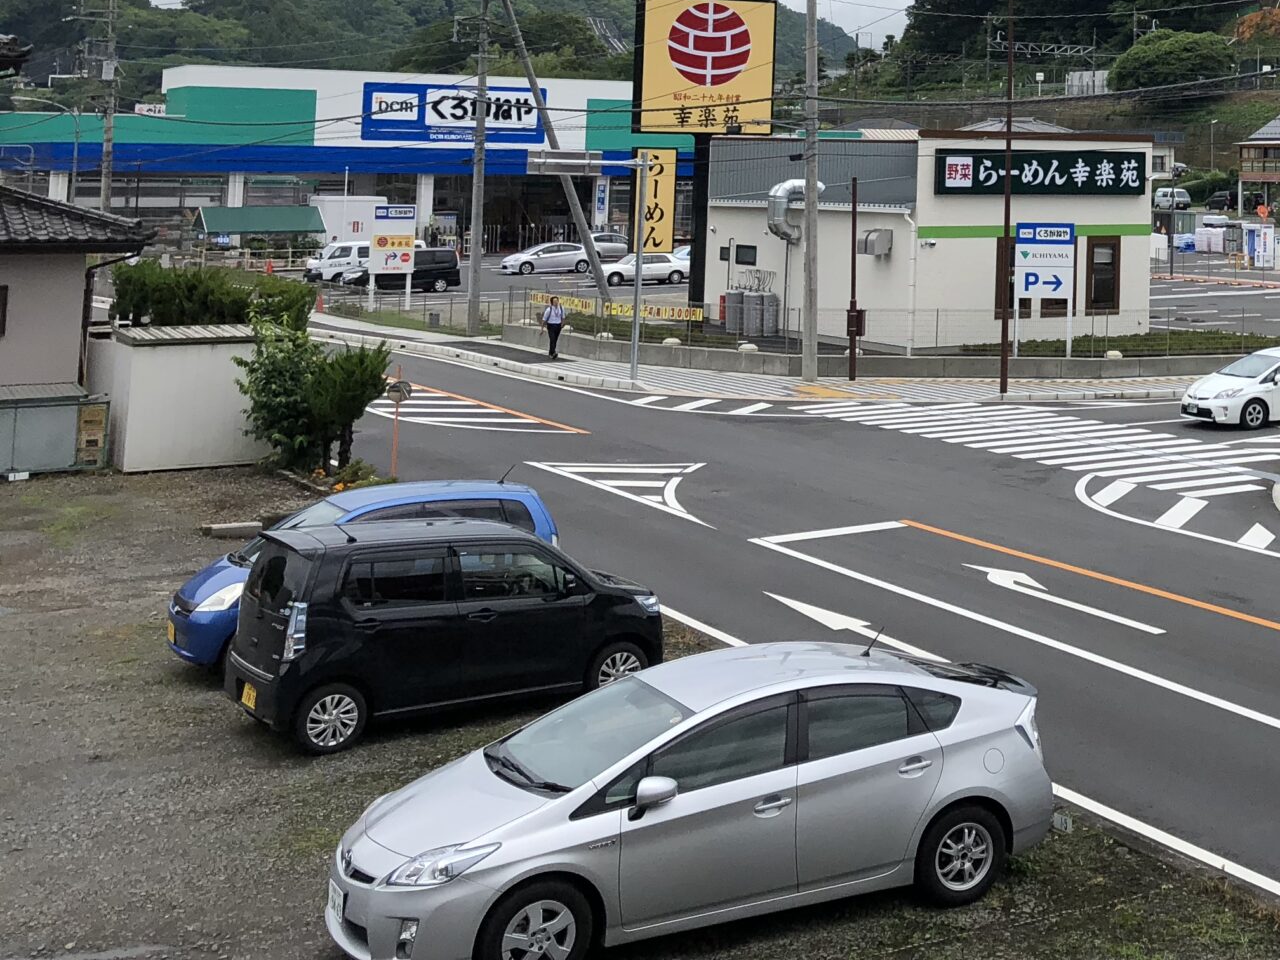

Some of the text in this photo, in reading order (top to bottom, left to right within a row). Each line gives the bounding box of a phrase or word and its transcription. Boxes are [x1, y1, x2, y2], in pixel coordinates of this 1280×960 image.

[379, 100, 413, 114] DCM
[673, 105, 740, 128] 幸楽苑
[947, 163, 972, 181] 野菜
[643, 154, 665, 248] らーめん
[1037, 229, 1069, 238] くろがねや
[1024, 272, 1040, 292] P
